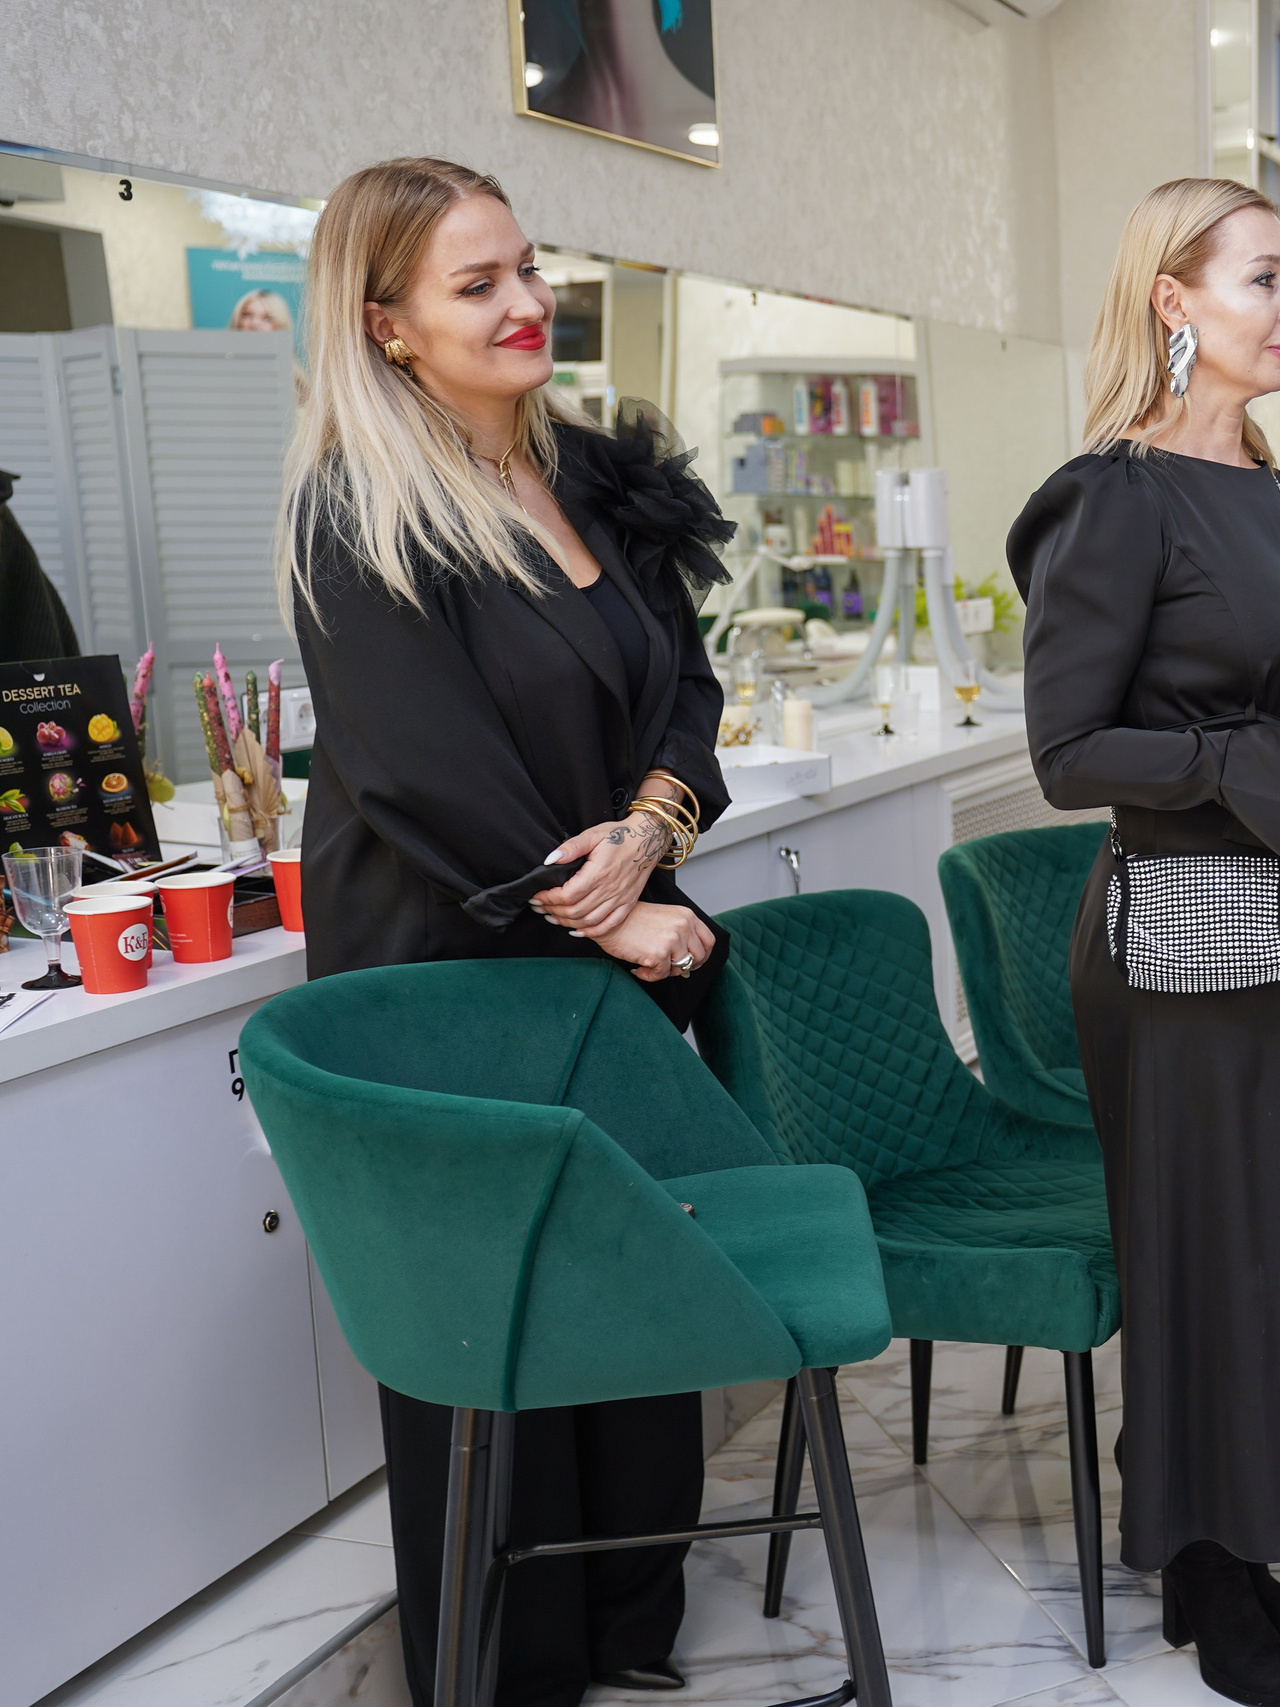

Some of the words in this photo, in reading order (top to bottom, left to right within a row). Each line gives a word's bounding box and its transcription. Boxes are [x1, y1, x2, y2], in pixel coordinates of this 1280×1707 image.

[118, 179, 133, 201] 3
[2, 685, 55, 702] DESSERT
[57, 683, 82, 696] TEA
[19, 699, 72, 714] Collection
